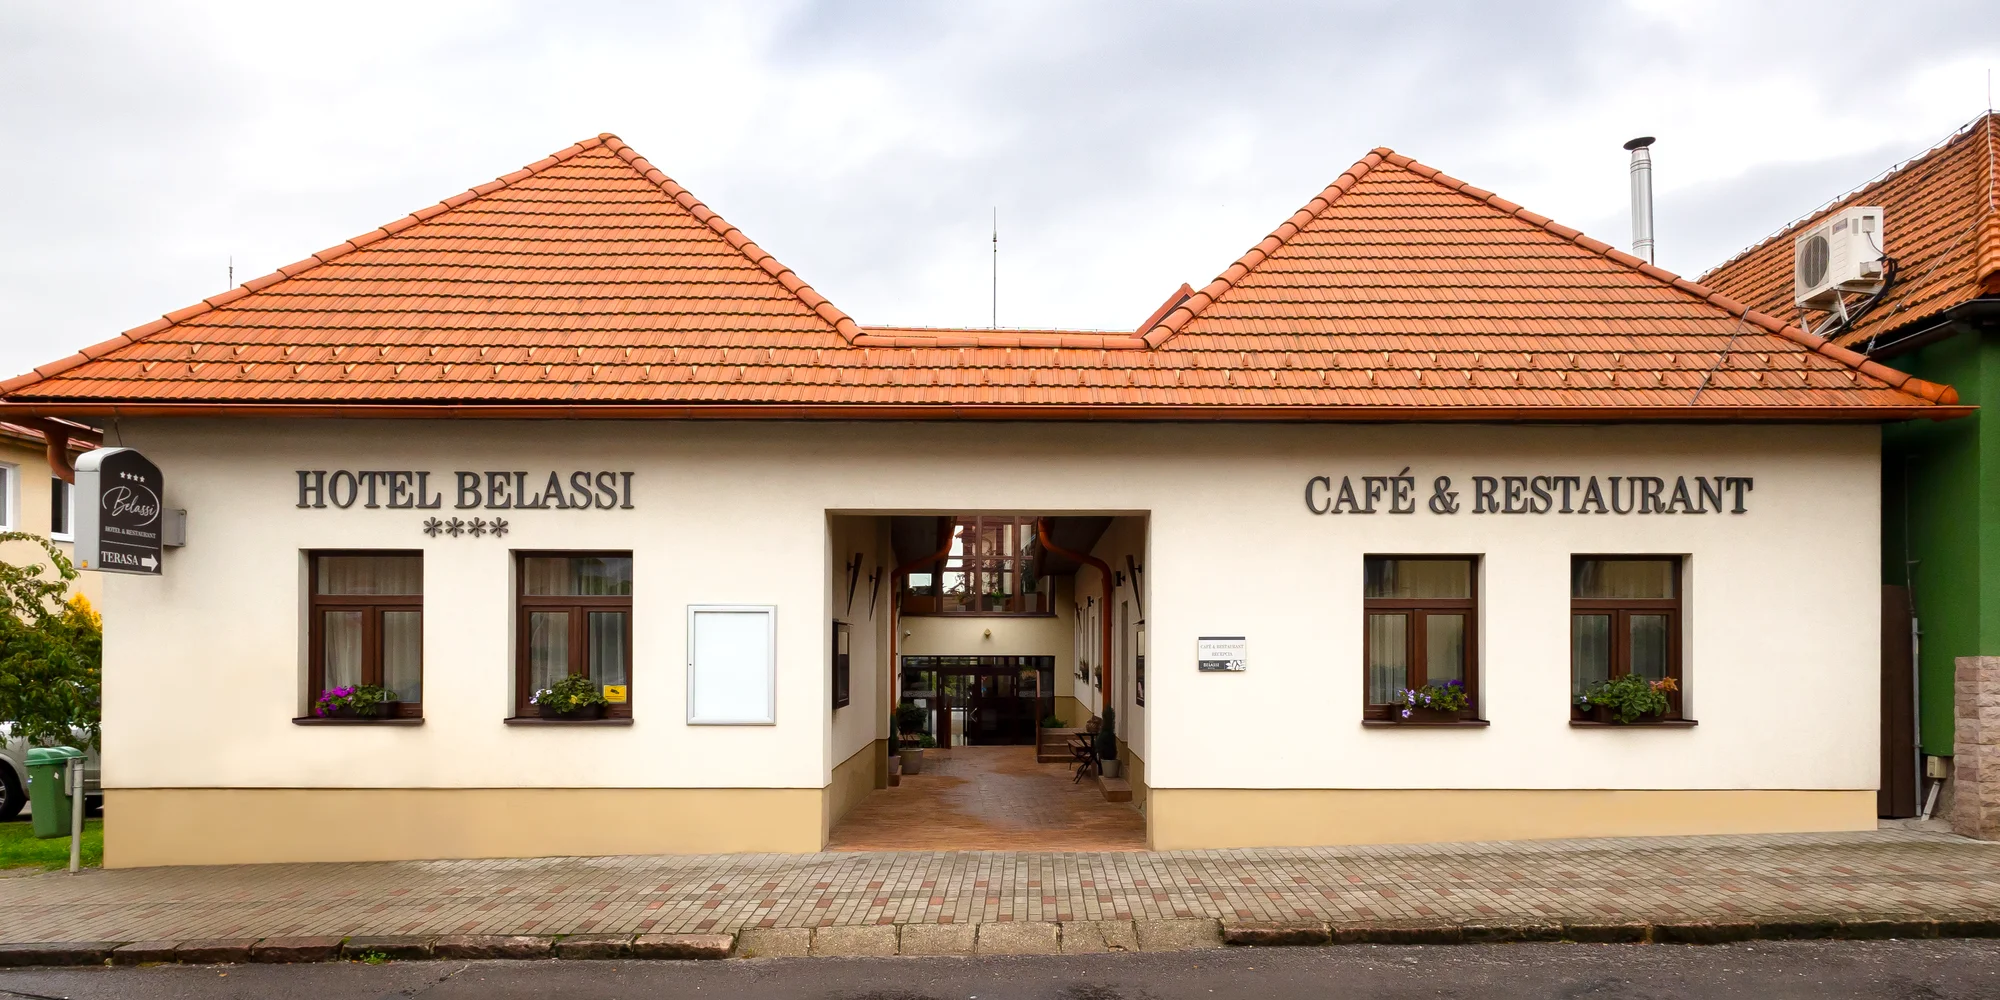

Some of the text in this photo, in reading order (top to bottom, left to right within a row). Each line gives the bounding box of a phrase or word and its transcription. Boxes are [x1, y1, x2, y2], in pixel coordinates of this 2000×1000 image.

[103, 486, 157, 516] Belassi
[295, 469, 635, 510] HOTEL BELASSI
[1305, 466, 1754, 515] CAFÉ & RESTAURANT
[105, 526, 121, 534] HOTEL
[126, 529, 156, 539] RESTAURANT
[101, 551, 139, 566] TERASA
